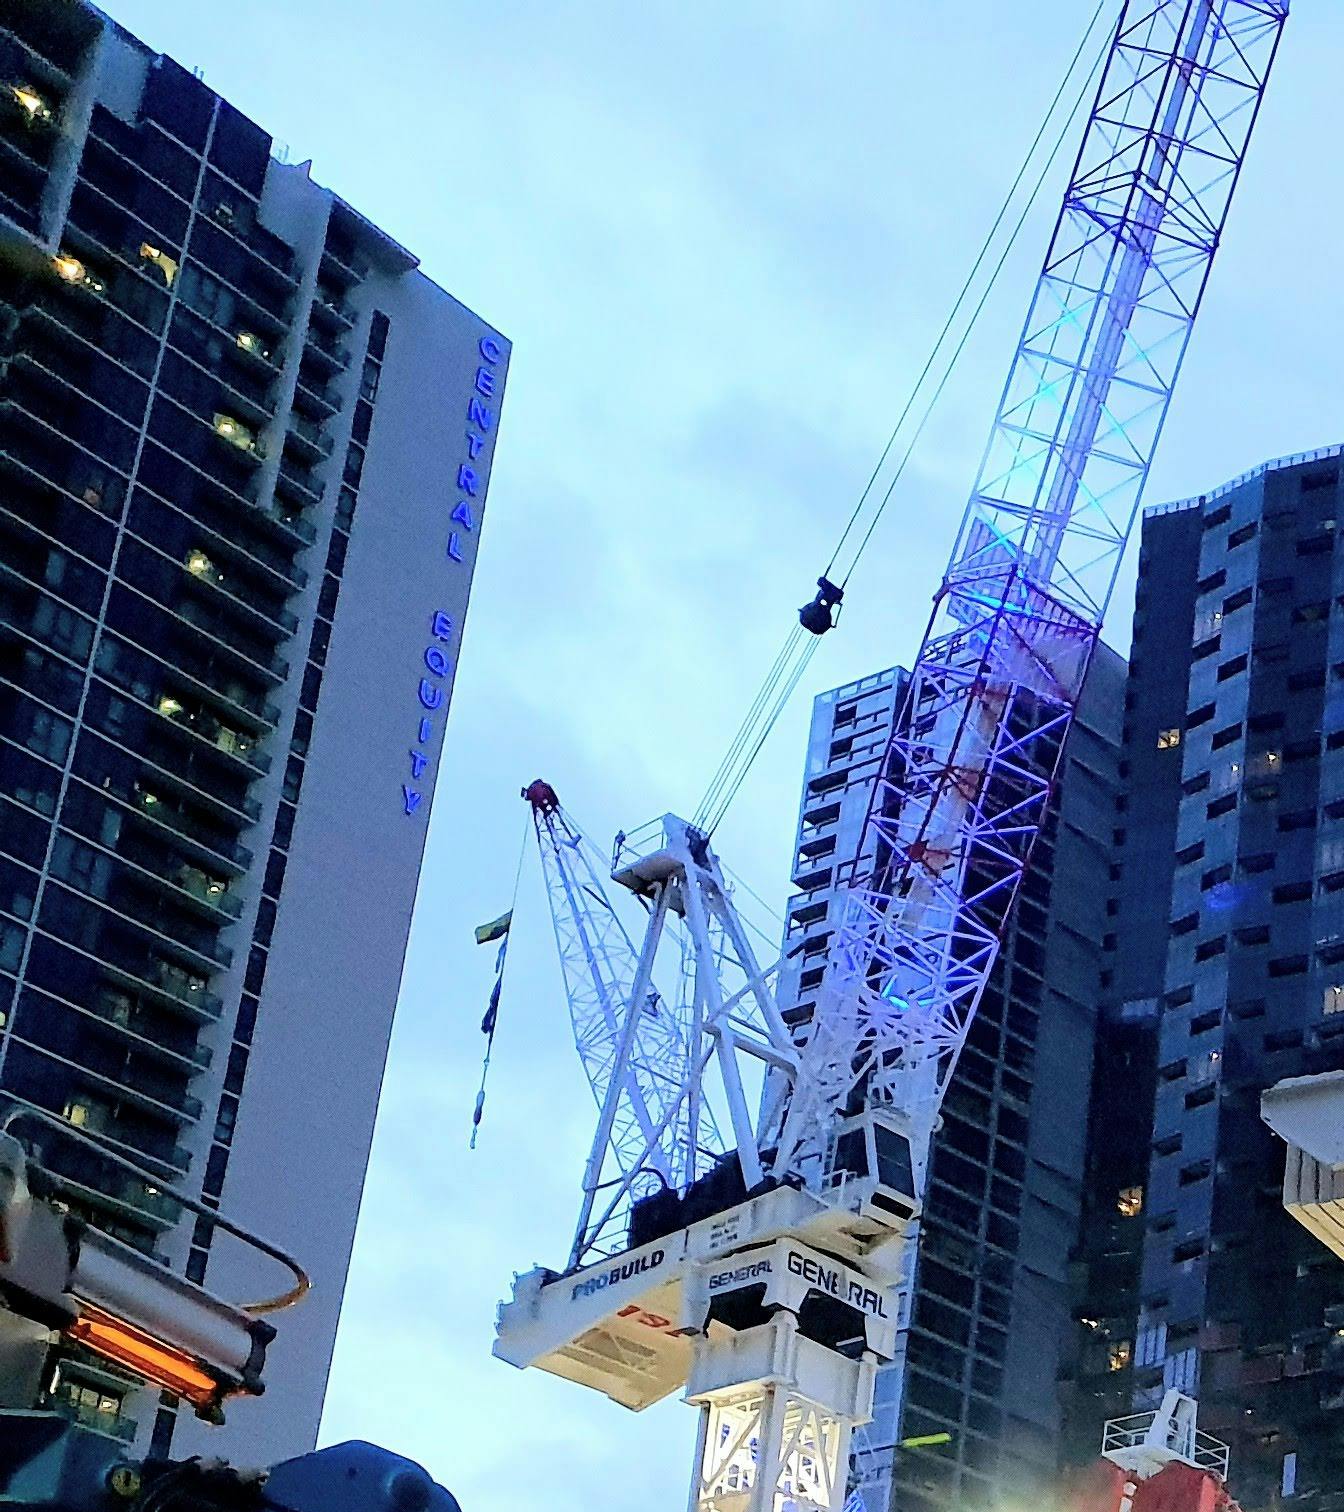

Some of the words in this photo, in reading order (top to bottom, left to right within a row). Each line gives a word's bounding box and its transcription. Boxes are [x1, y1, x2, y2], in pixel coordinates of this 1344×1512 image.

[447, 335, 502, 562] CENTRAL
[402, 608, 453, 815] EQUITY
[570, 1250, 665, 1301] PROBUILD
[708, 1259, 773, 1289] GENERAL
[786, 1250, 889, 1319] GENERAL
